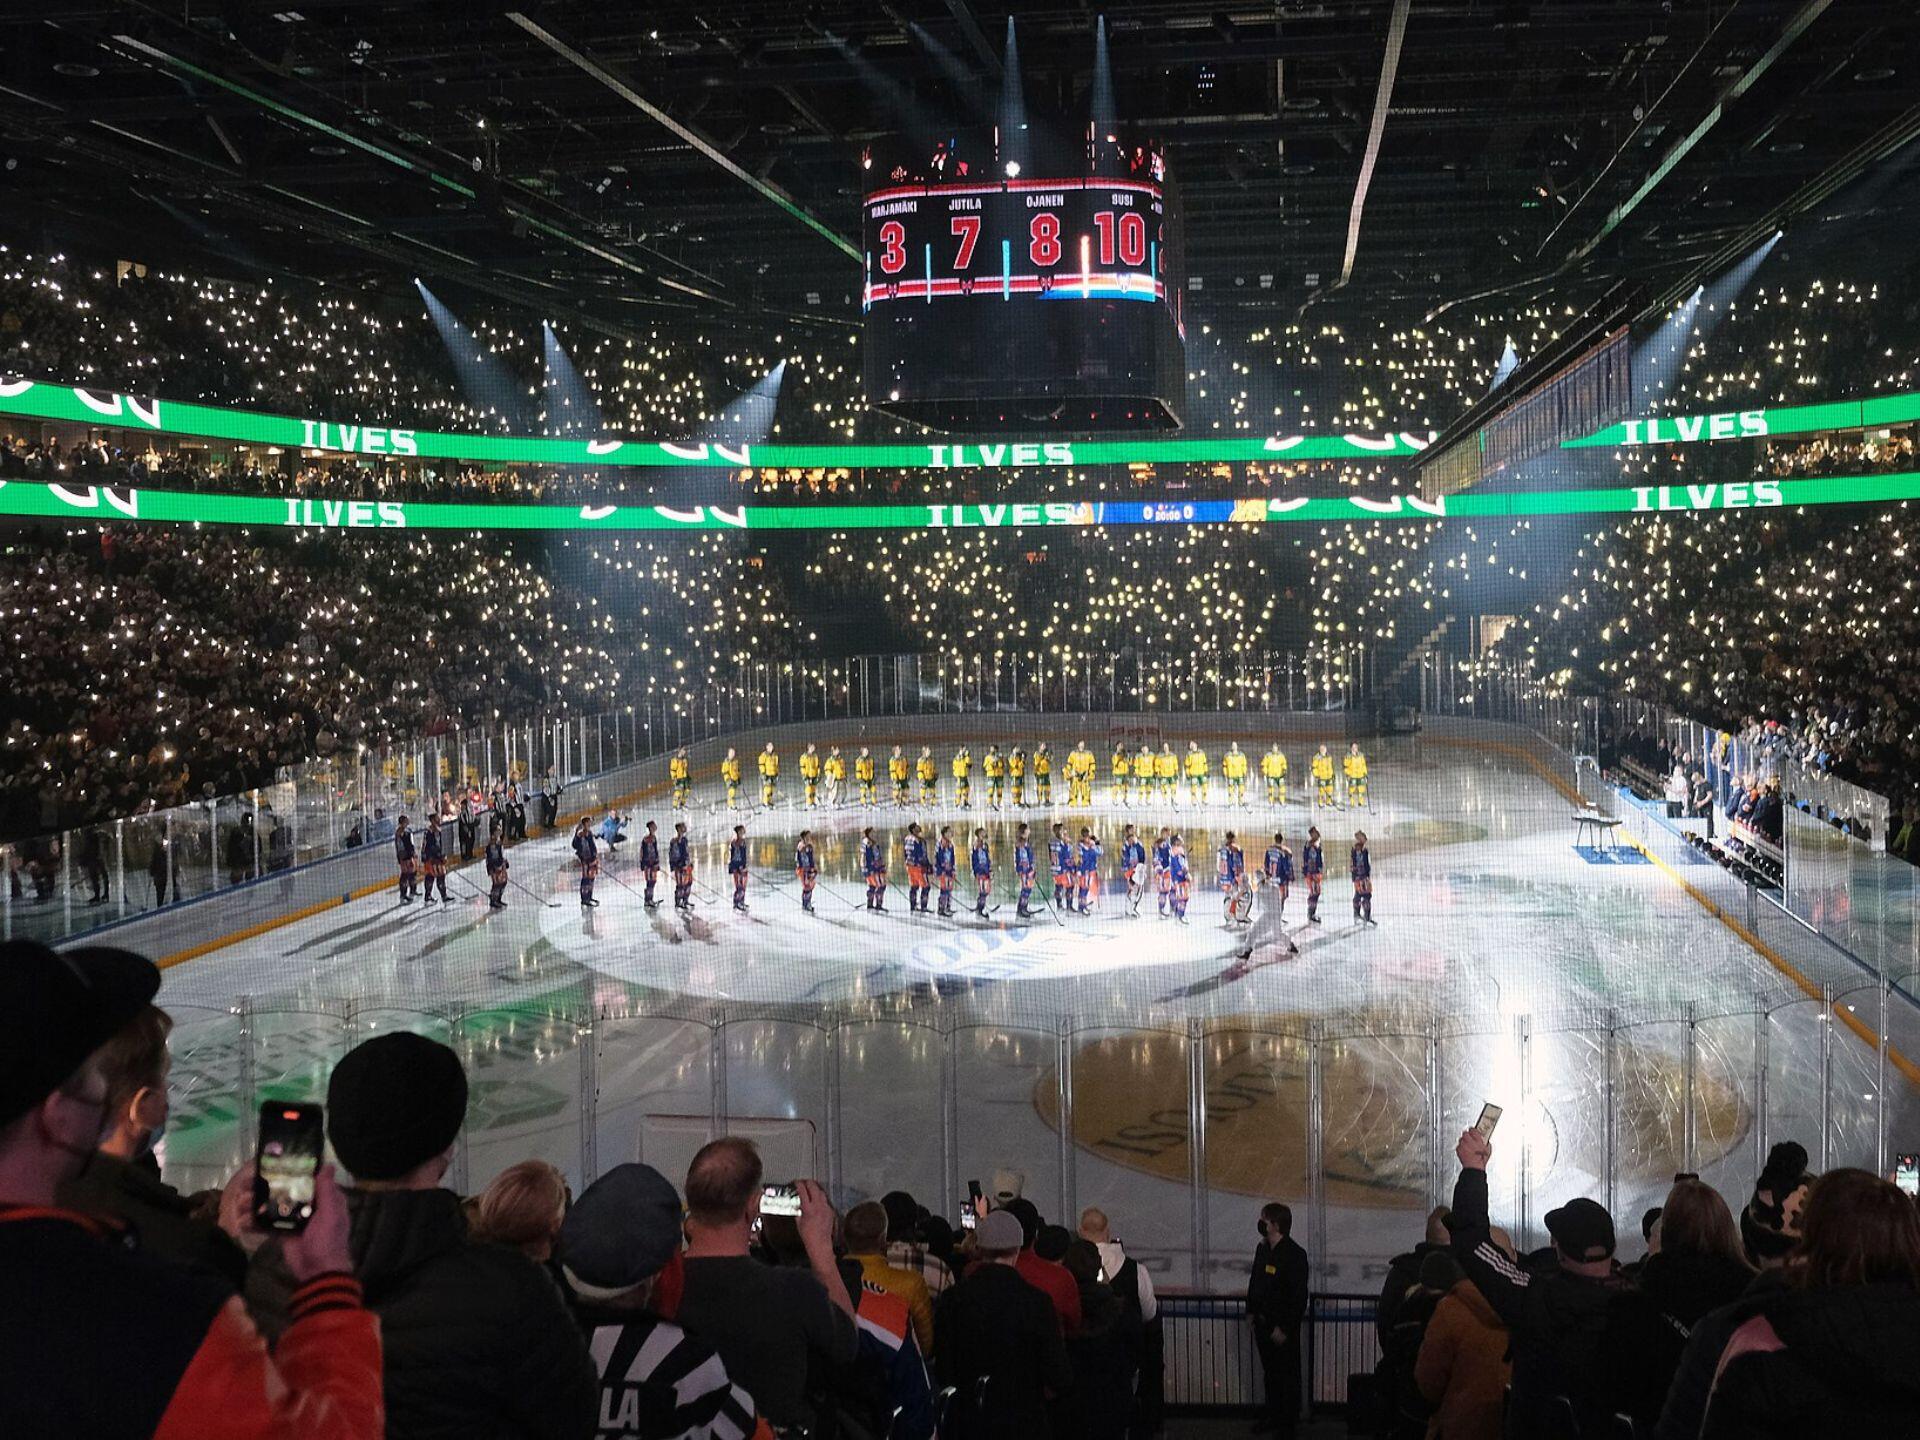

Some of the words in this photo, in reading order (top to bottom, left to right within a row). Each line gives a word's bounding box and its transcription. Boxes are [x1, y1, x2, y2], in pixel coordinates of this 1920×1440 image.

[948, 198, 982, 211] JUTILA
[880, 221, 906, 274] 3
[951, 215, 981, 270] 7
[1029, 212, 1061, 266] 8
[1094, 211, 1145, 266] 10
[301, 419, 418, 457] ILVES
[1620, 409, 1768, 445] ILVES
[927, 442, 1074, 467] ILVES
[283, 498, 406, 528] ILVES
[1631, 480, 1784, 511] ILVES
[926, 503, 1073, 527] ILVES
